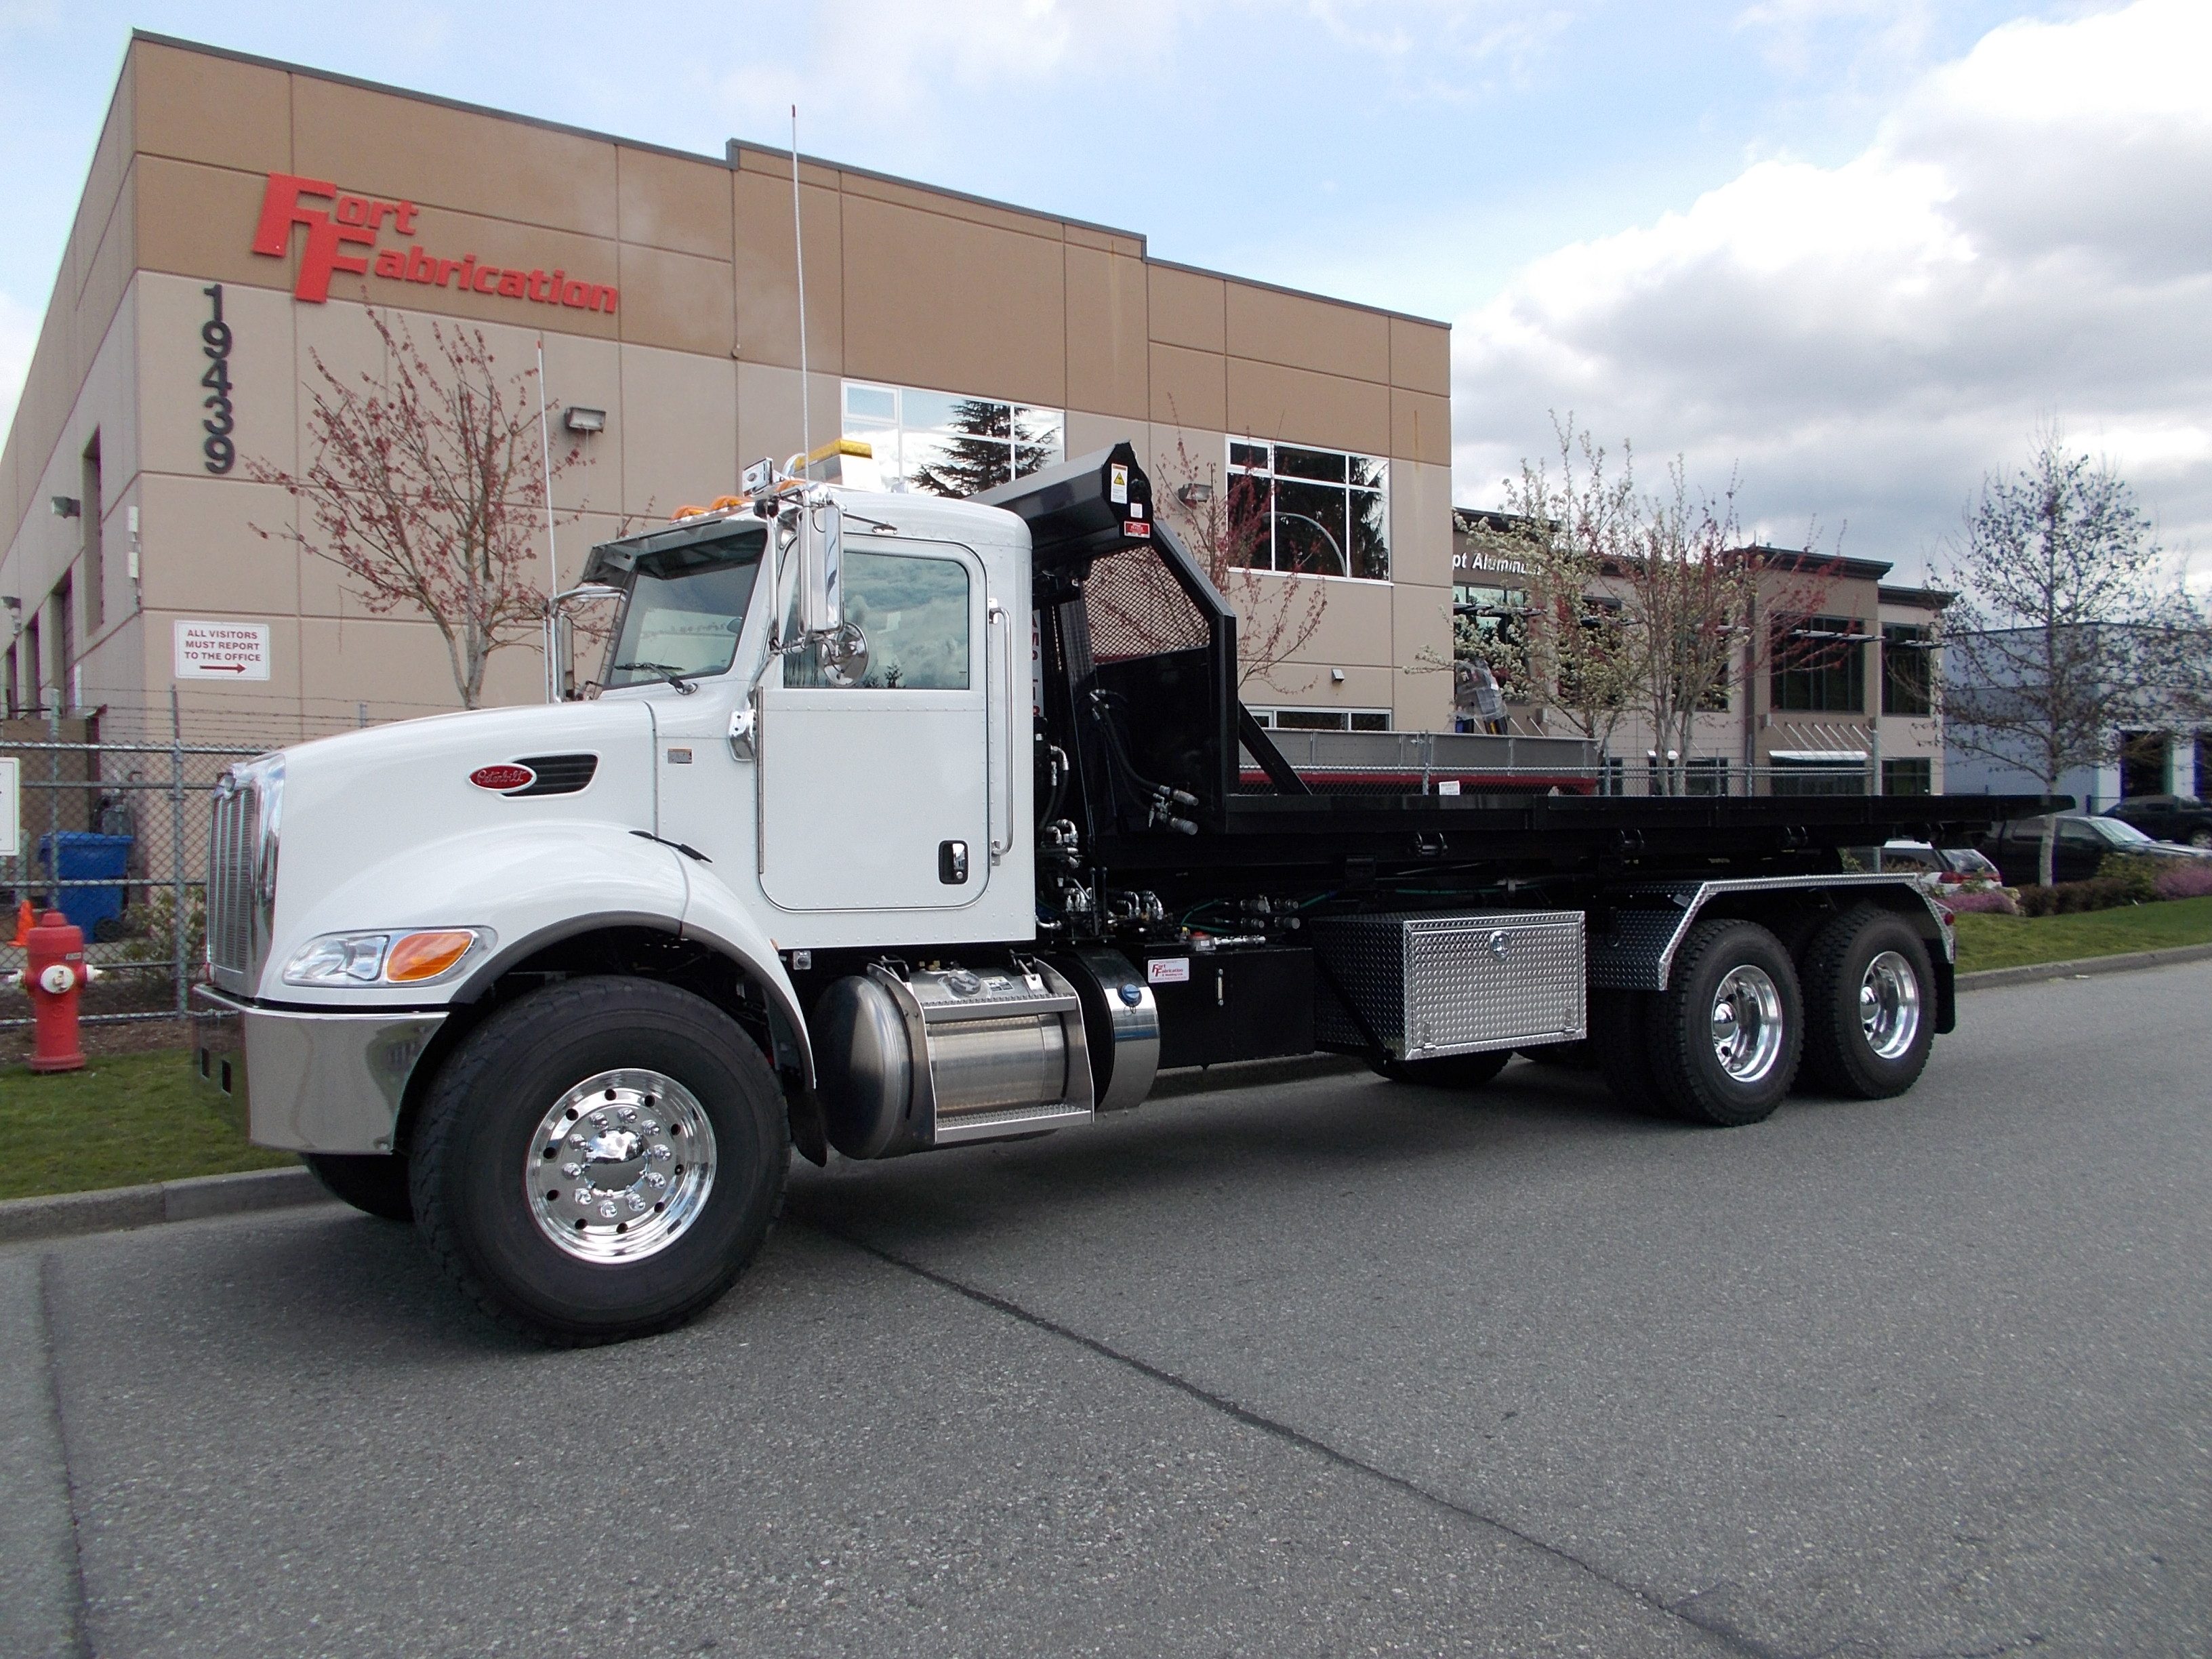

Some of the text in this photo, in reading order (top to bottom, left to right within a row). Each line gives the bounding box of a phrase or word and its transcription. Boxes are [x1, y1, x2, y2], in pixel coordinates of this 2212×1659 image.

[252, 171, 419, 257] Fort
[294, 220, 618, 314] Fabrication
[201, 283, 236, 474] 19439
[187, 630, 258, 640] ALL VISITORS
[219, 642, 260, 650] REPORT
[201, 652, 221, 660] THE
[224, 653, 262, 661] OFFICE
[476, 769, 528, 784] Peterbilt
